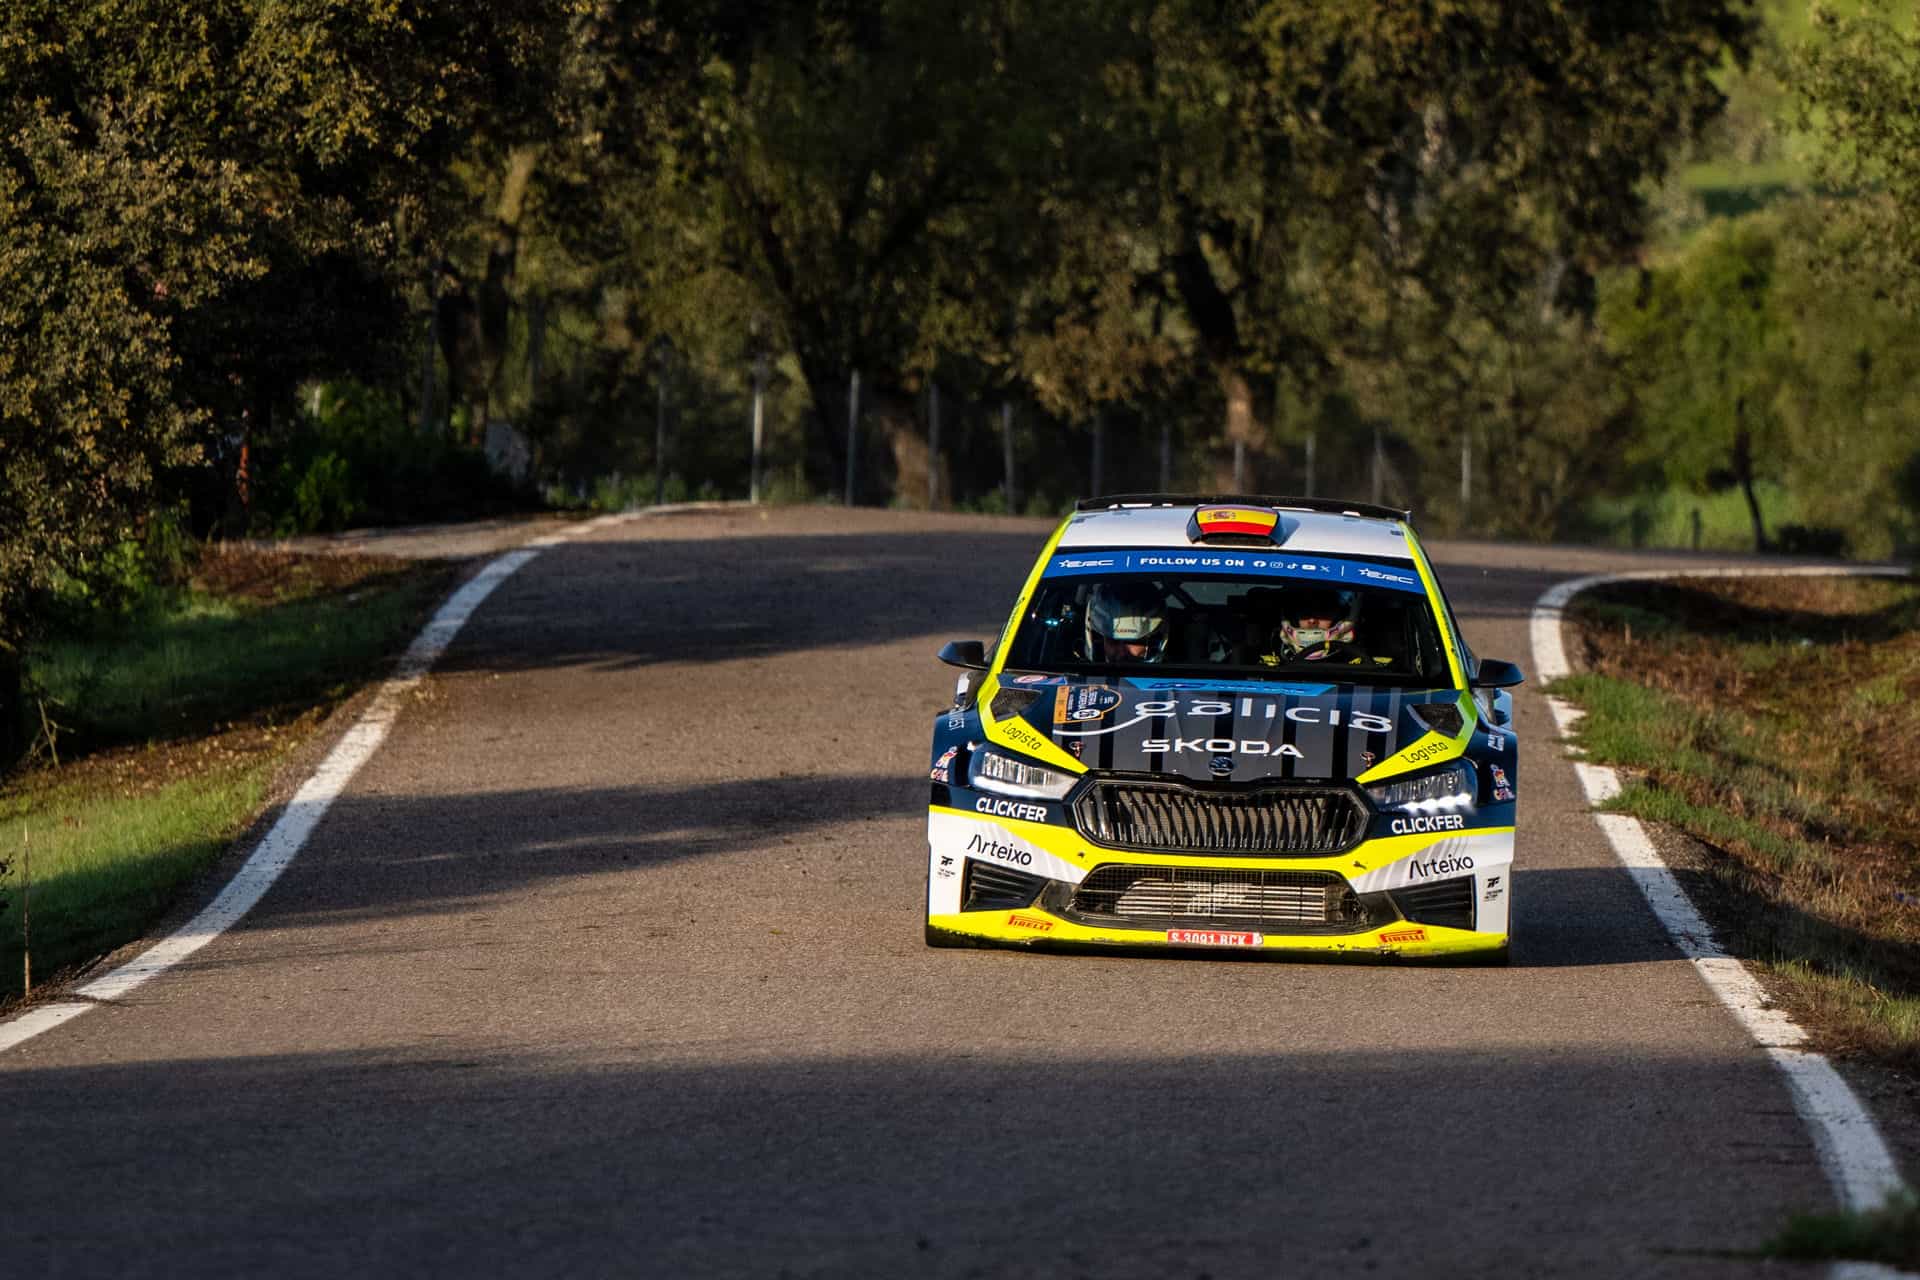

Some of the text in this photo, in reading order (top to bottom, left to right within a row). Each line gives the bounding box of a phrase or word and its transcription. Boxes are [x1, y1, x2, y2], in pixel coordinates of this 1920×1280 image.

[1140, 558, 1245, 567] FOLLOW US ON
[975, 797, 1048, 822] CLICKFER
[1391, 814, 1464, 834] CLICKFER
[966, 834, 1032, 866] Arteixo
[1409, 854, 1474, 880] Arteixo
[1008, 914, 1053, 932] PIRELLI
[1379, 929, 1425, 943] PIRELLI
